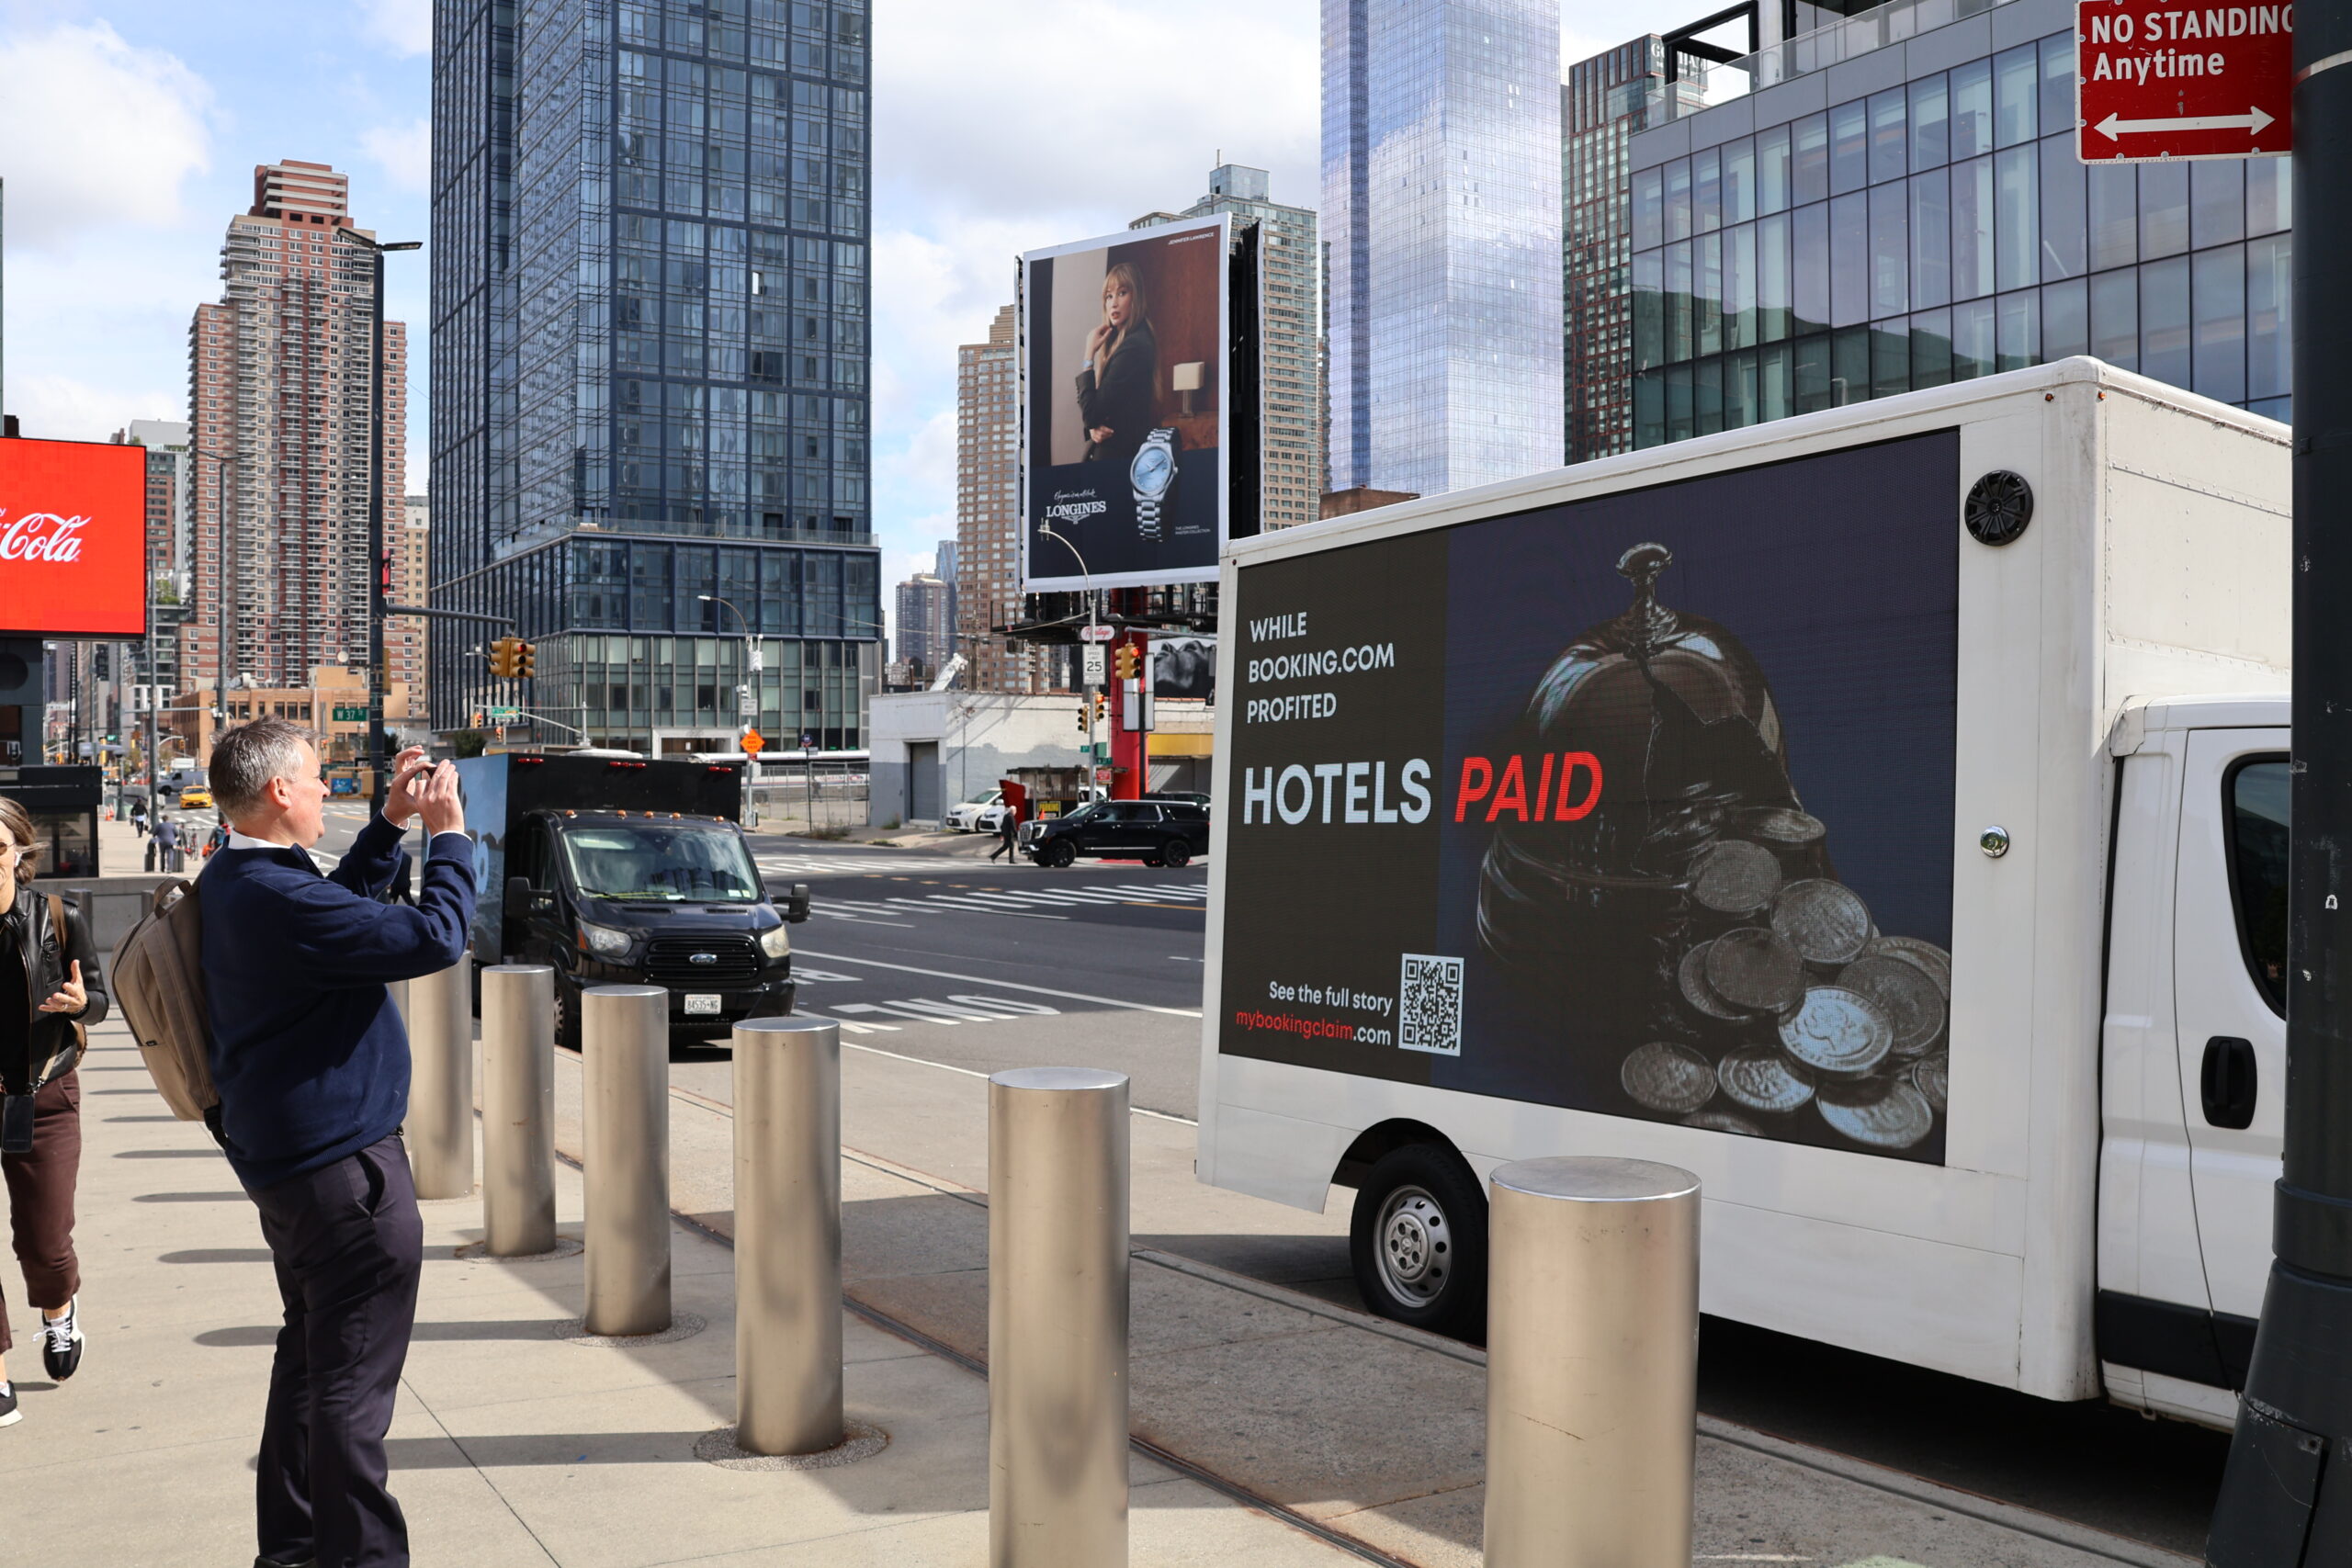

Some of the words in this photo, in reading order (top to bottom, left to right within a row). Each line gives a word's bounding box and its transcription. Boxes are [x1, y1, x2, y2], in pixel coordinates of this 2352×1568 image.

[2091, 14, 2134, 44] NO
[2092, 48, 2225, 85] Anytime
[1190, 231, 1215, 242] LAWRENCE
[1046, 501, 1107, 517] LONGINES
[1250, 612, 1307, 643] WHILE
[1086, 661, 1102, 671] 25
[1249, 642, 1395, 682] BOOKING.COM
[336, 710, 344, 720] W
[345, 710, 356, 720] 37
[1247, 692, 1337, 724] PROFITED
[1243, 758, 1432, 825] HOTELS
[1454, 750, 1603, 823] PAID
[1269, 980, 1295, 1001] See
[1298, 984, 1322, 1005] the
[1326, 986, 1350, 1008] full
[1352, 991, 1393, 1017] story
[1235, 1010, 1391, 1046] mybookingclaim.com
